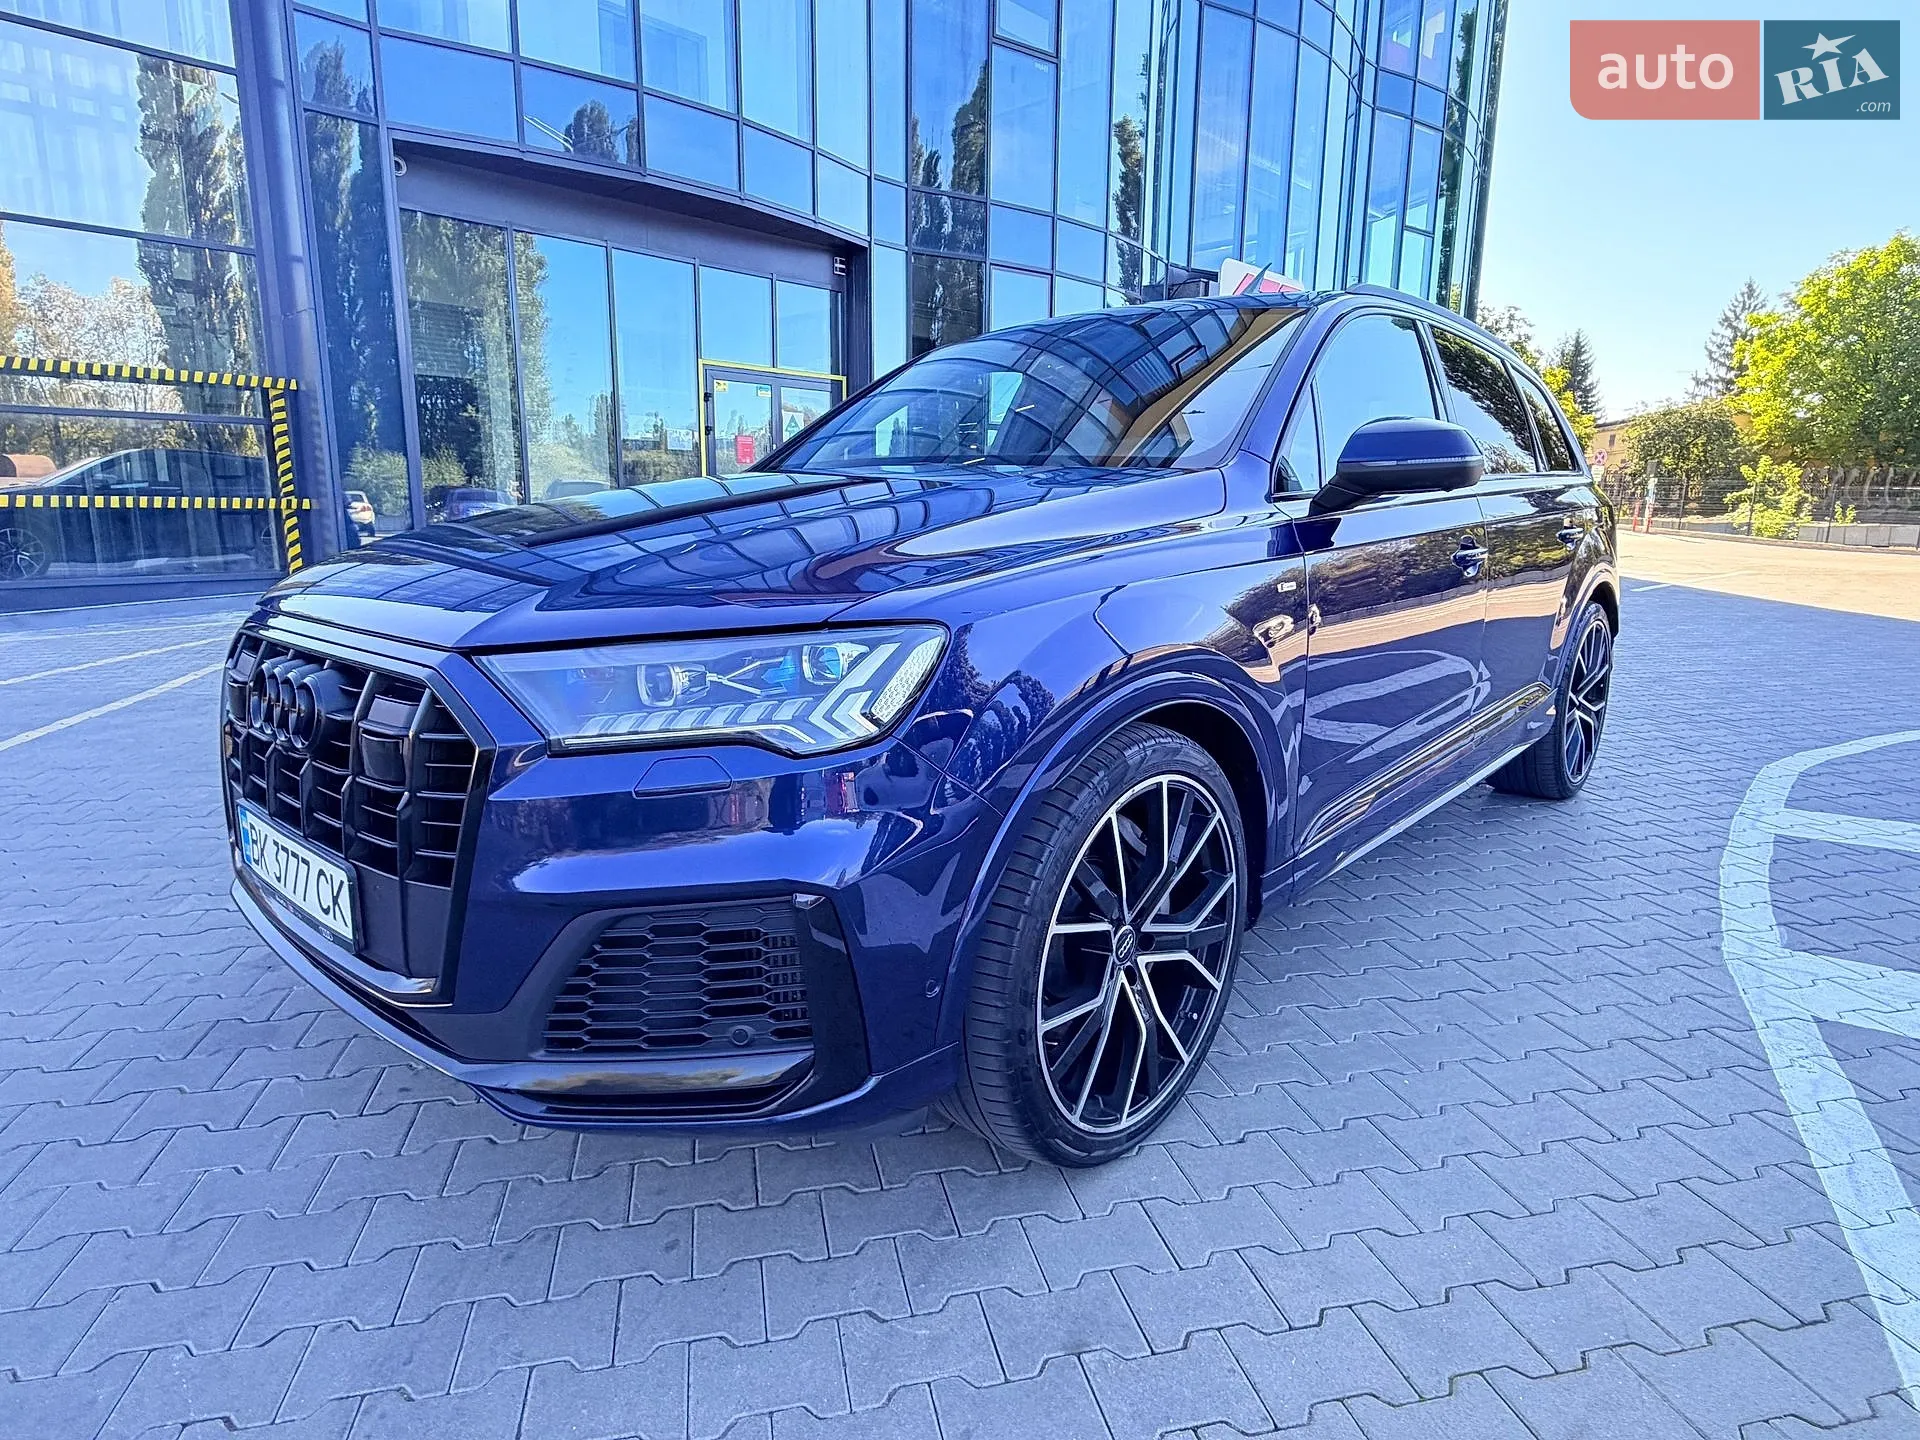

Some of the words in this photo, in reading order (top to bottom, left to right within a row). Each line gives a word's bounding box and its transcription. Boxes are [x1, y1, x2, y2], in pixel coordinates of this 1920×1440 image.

[249, 822, 270, 875] BK
[272, 839, 310, 902] 3777
[316, 868, 350, 928] CK
